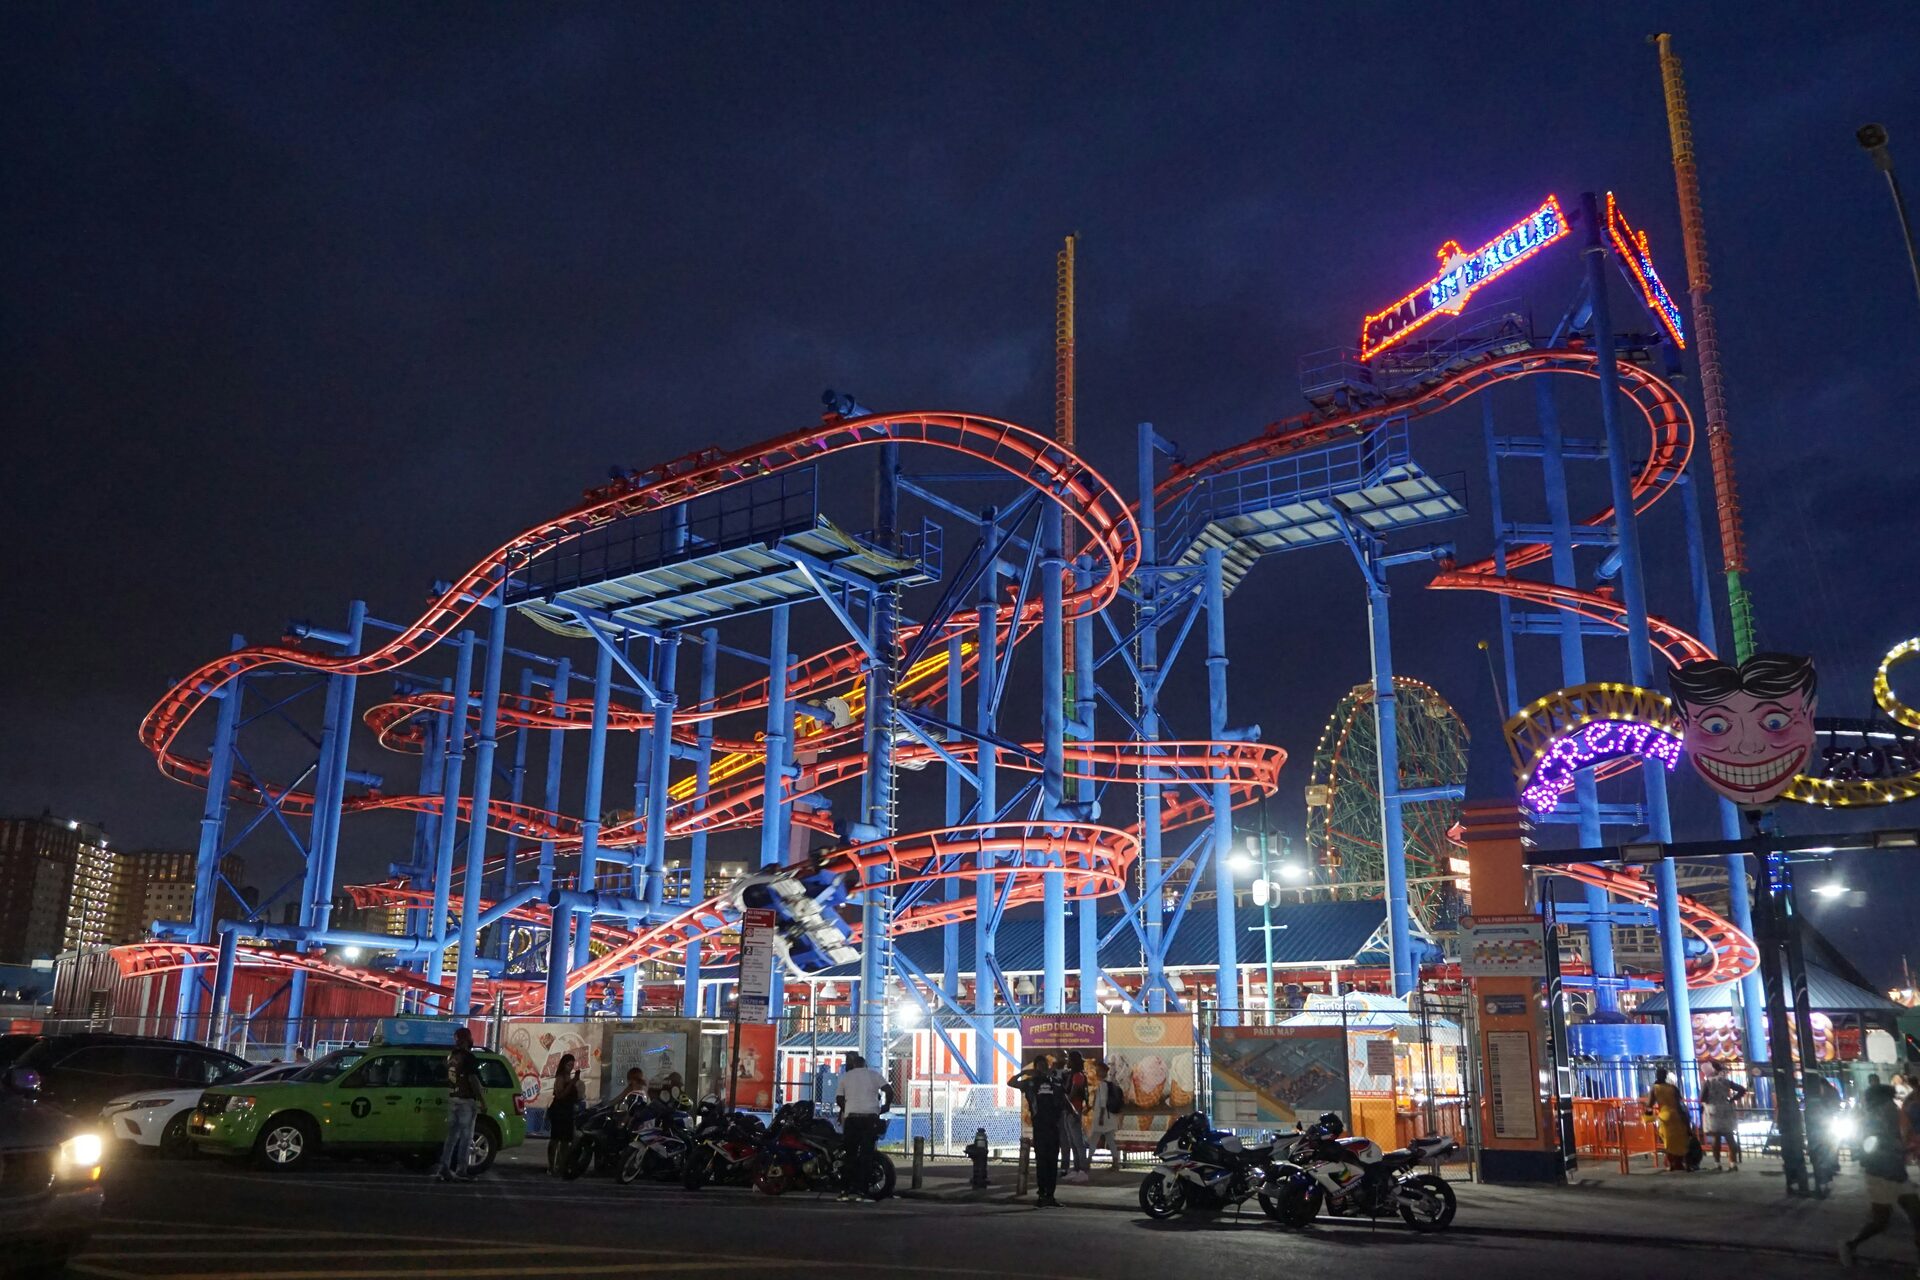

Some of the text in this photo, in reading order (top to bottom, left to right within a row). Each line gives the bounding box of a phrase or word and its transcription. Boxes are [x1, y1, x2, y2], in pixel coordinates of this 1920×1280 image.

[1464, 206, 1559, 287] EAGLE
[1029, 1022, 1095, 1035] FRIED DELIGHTS
[1253, 1028, 1295, 1036] PARK MAP
[521, 1084, 540, 1100] 2019
[355, 1101, 368, 1115] T
